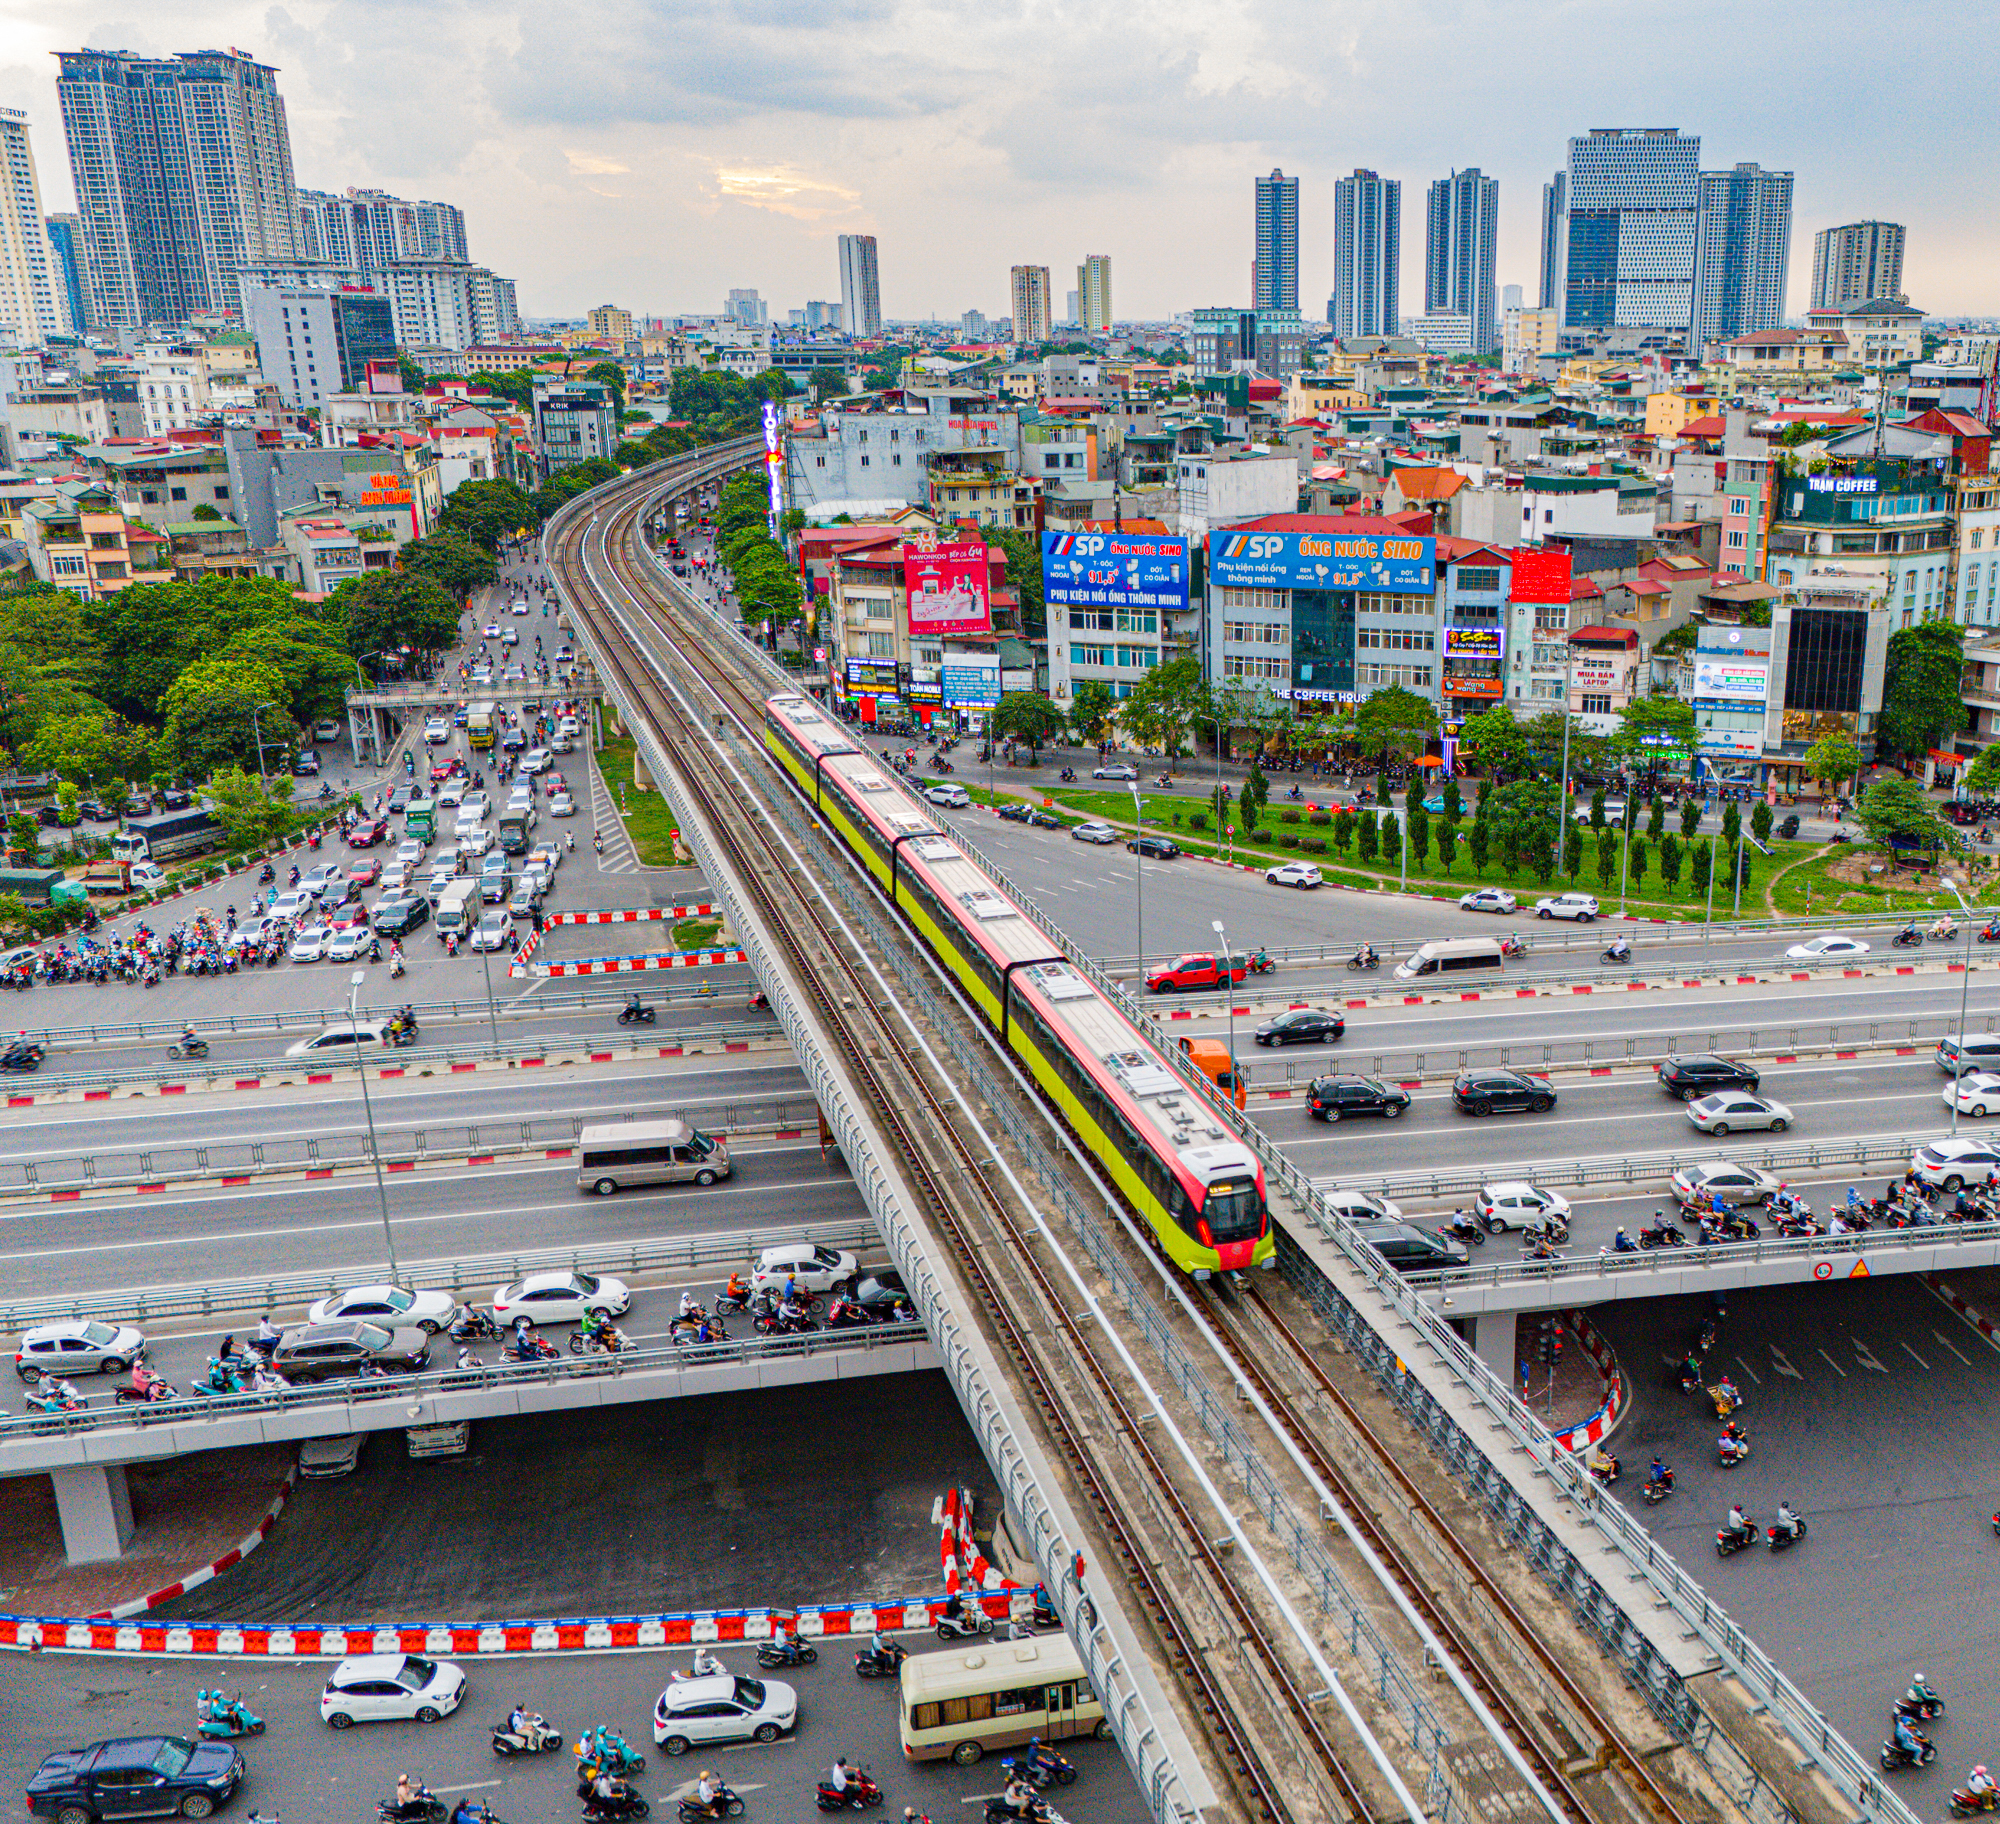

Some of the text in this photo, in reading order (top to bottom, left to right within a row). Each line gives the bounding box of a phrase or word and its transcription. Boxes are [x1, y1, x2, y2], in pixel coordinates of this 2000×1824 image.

[588, 422, 597, 453] KRI
[1836, 479, 1877, 492] COFFEE
[1076, 536, 1104, 556] SP
[1110, 541, 1182, 556] ỐNG NƯỚC SINO
[1249, 536, 1284, 558] SP
[1299, 535, 1424, 560] ỐNG NƯỚC SINO
[1218, 562, 1286, 574] Phụ kiện nối ống
[1228, 574, 1276, 584] thông minh
[1050, 588, 1182, 606] PHỤ KIỆN NỐI ỐNG THÔNG MINH
[1598, 671, 1615, 679] BÁN
[924, 685, 942, 694] MOBILE
[1294, 690, 1336, 702] COFFEE
